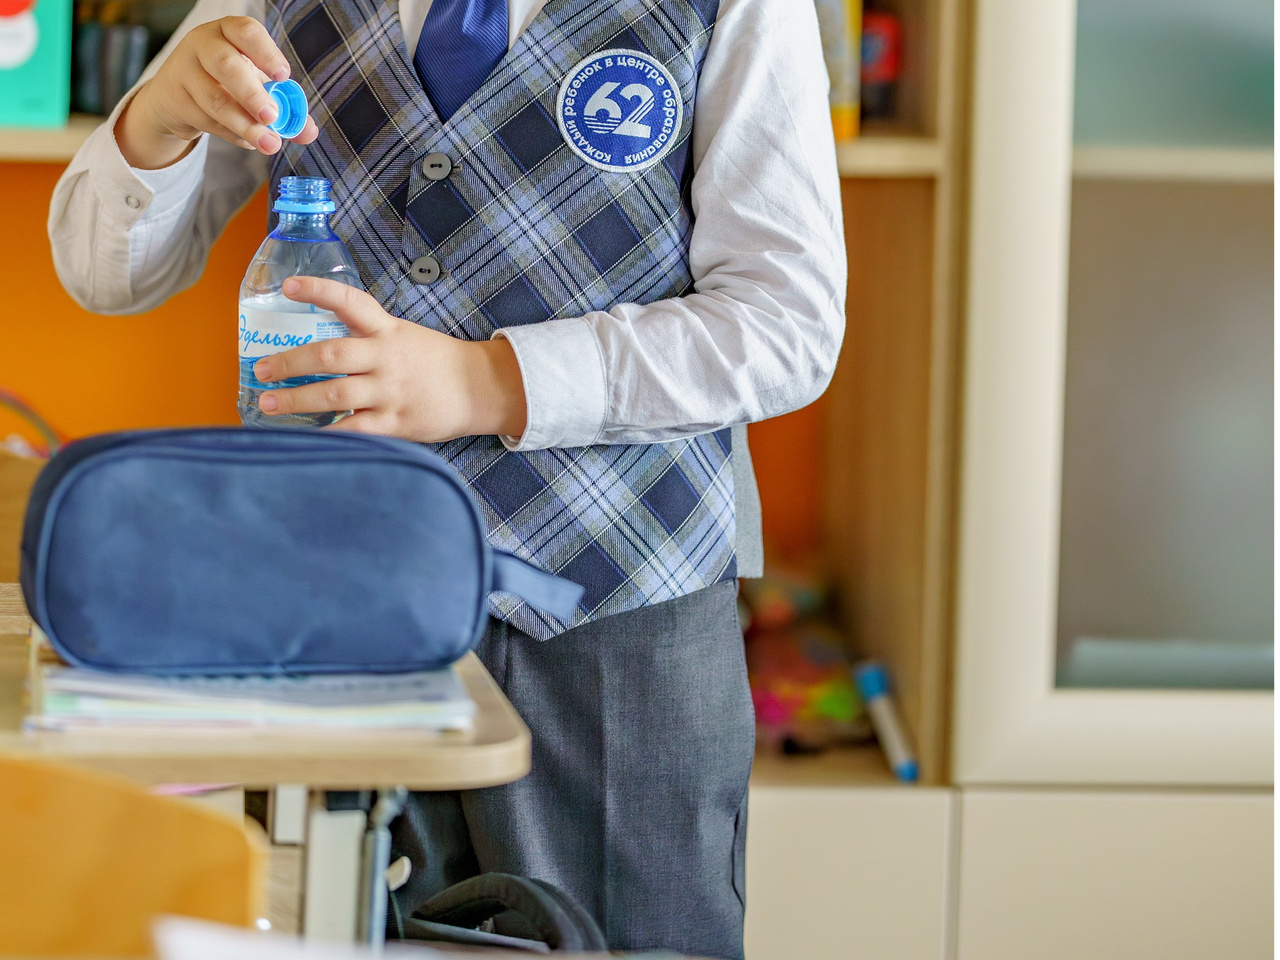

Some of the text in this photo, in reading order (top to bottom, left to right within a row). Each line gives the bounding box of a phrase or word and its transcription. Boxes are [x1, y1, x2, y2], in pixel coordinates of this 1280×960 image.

[564, 56, 677, 165] каждый ребенок в центре образования
[583, 81, 655, 138] 62
